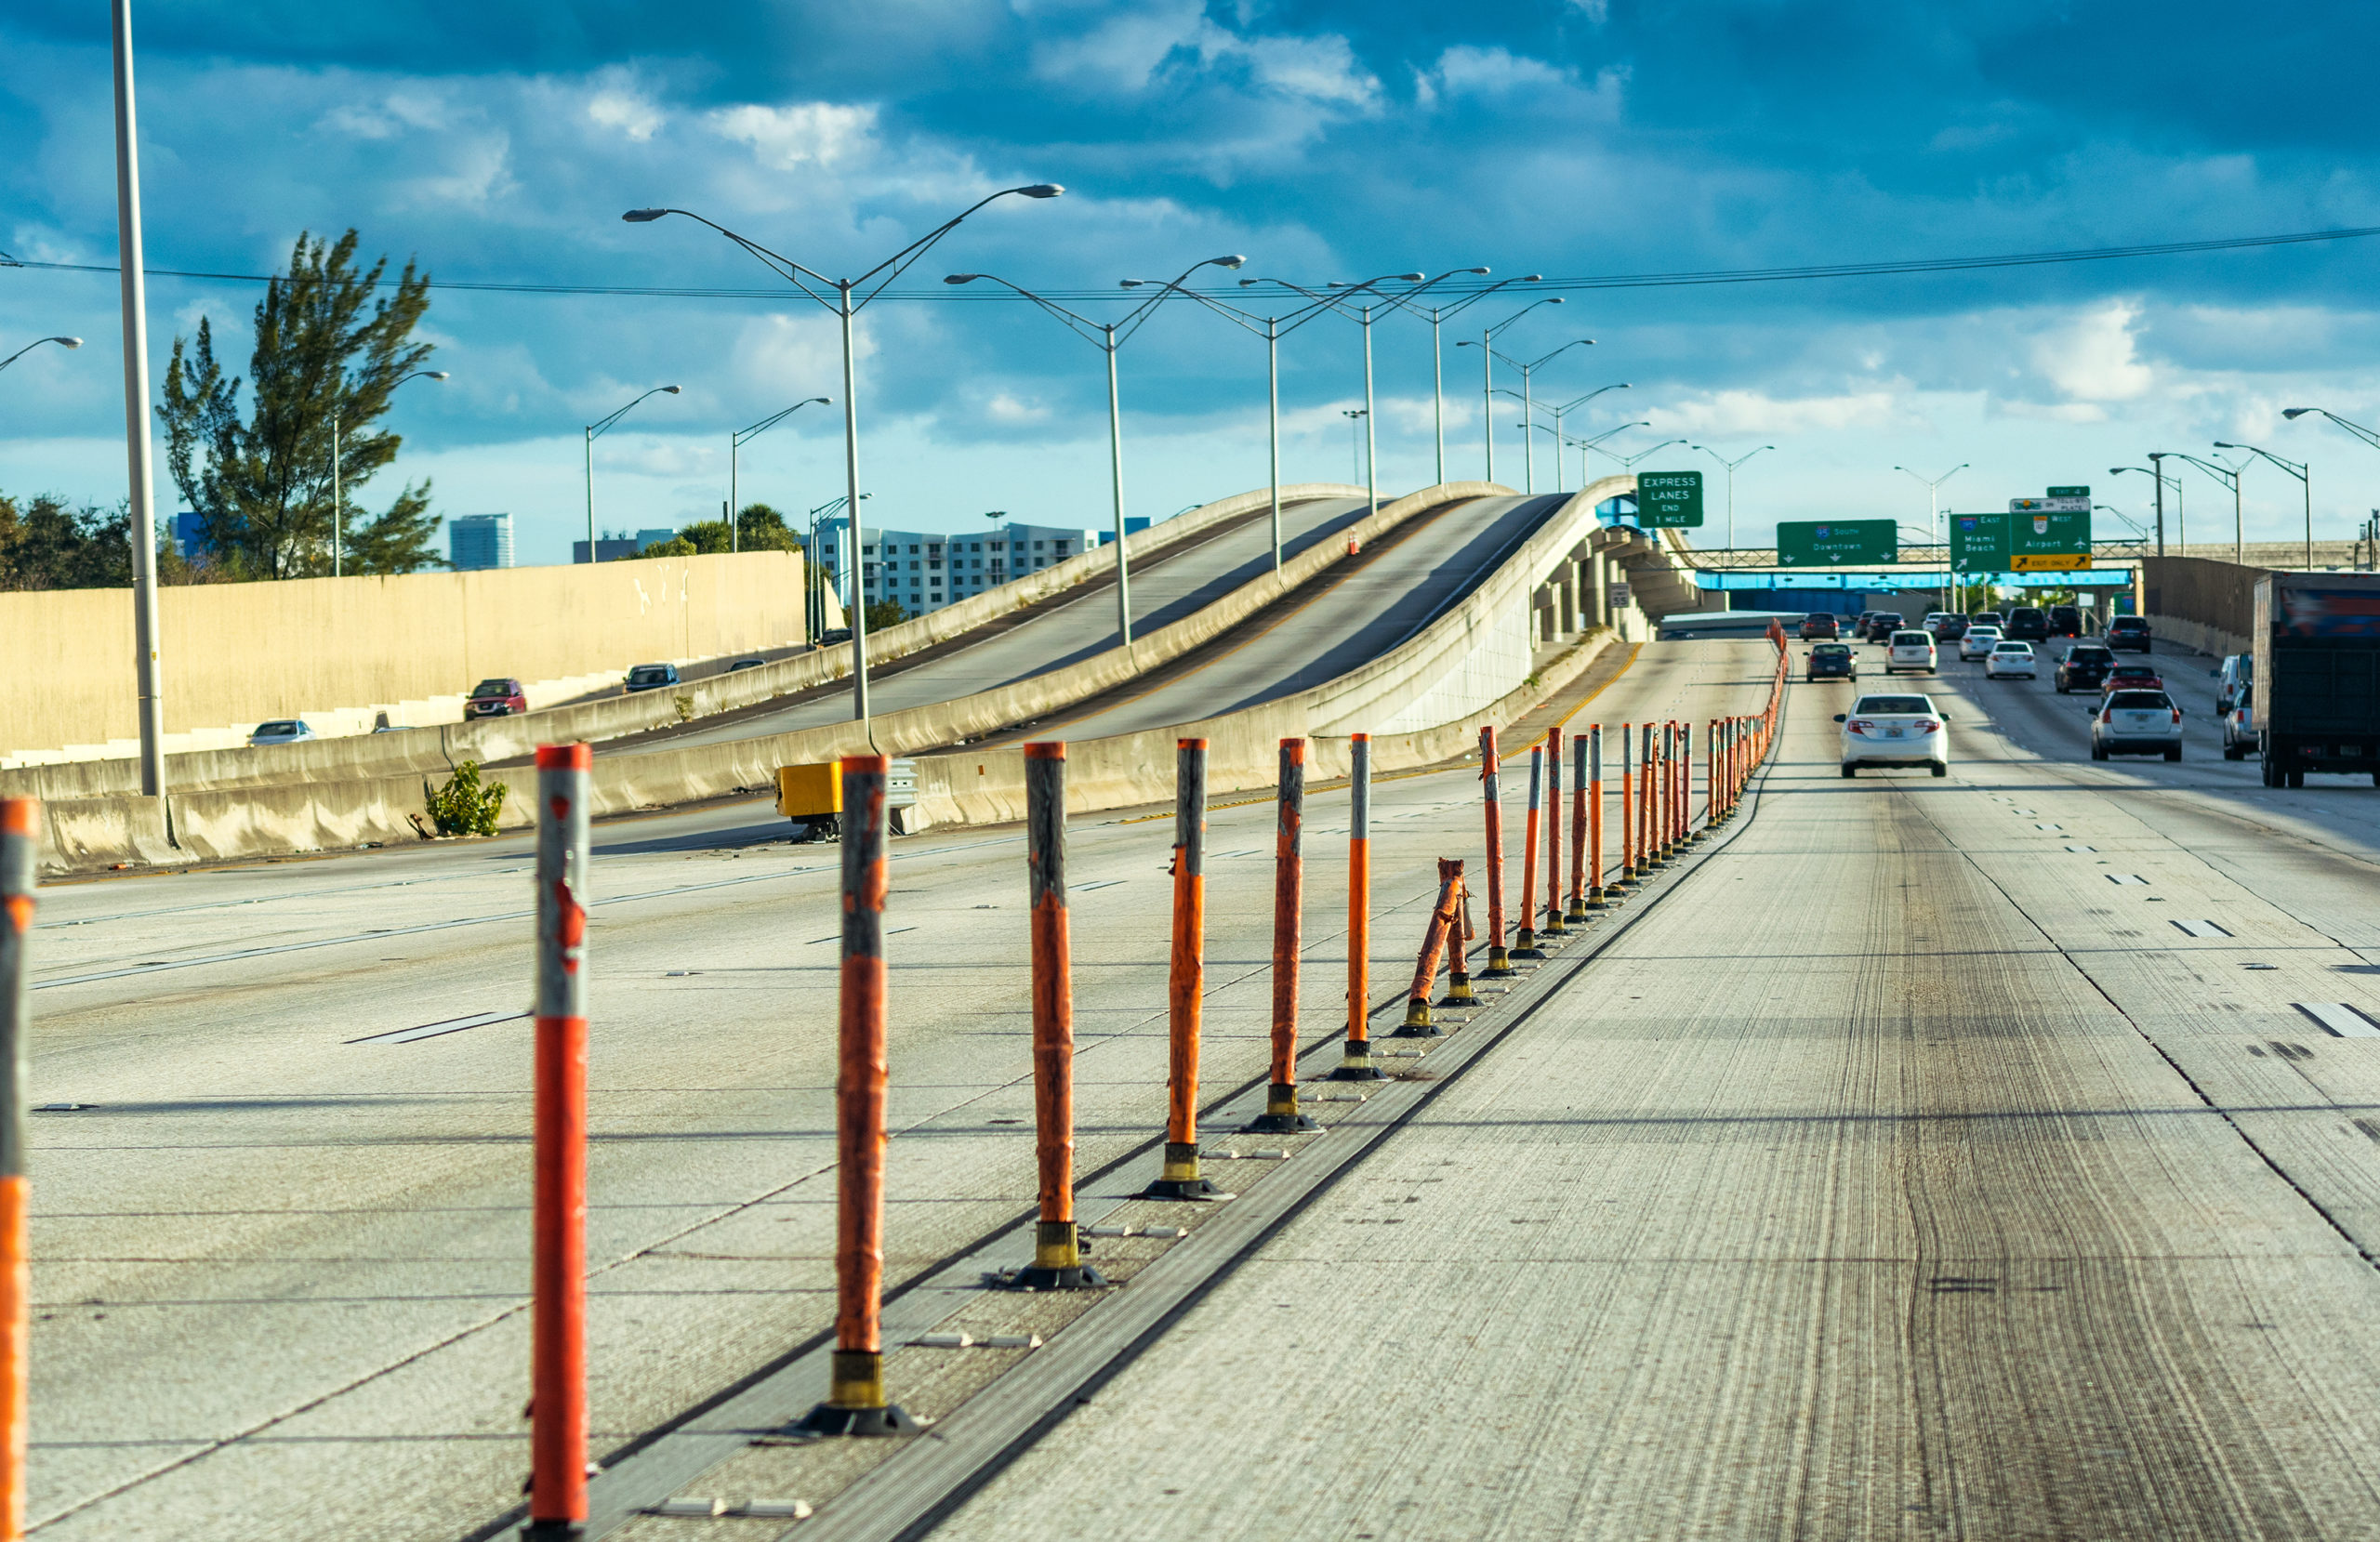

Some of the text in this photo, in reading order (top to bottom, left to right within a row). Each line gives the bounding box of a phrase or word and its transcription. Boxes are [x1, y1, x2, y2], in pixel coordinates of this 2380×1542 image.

[1644, 478, 1696, 487] EXPRESS
[1651, 491, 1689, 500] LANES
[1613, 597, 1628, 605] 55
